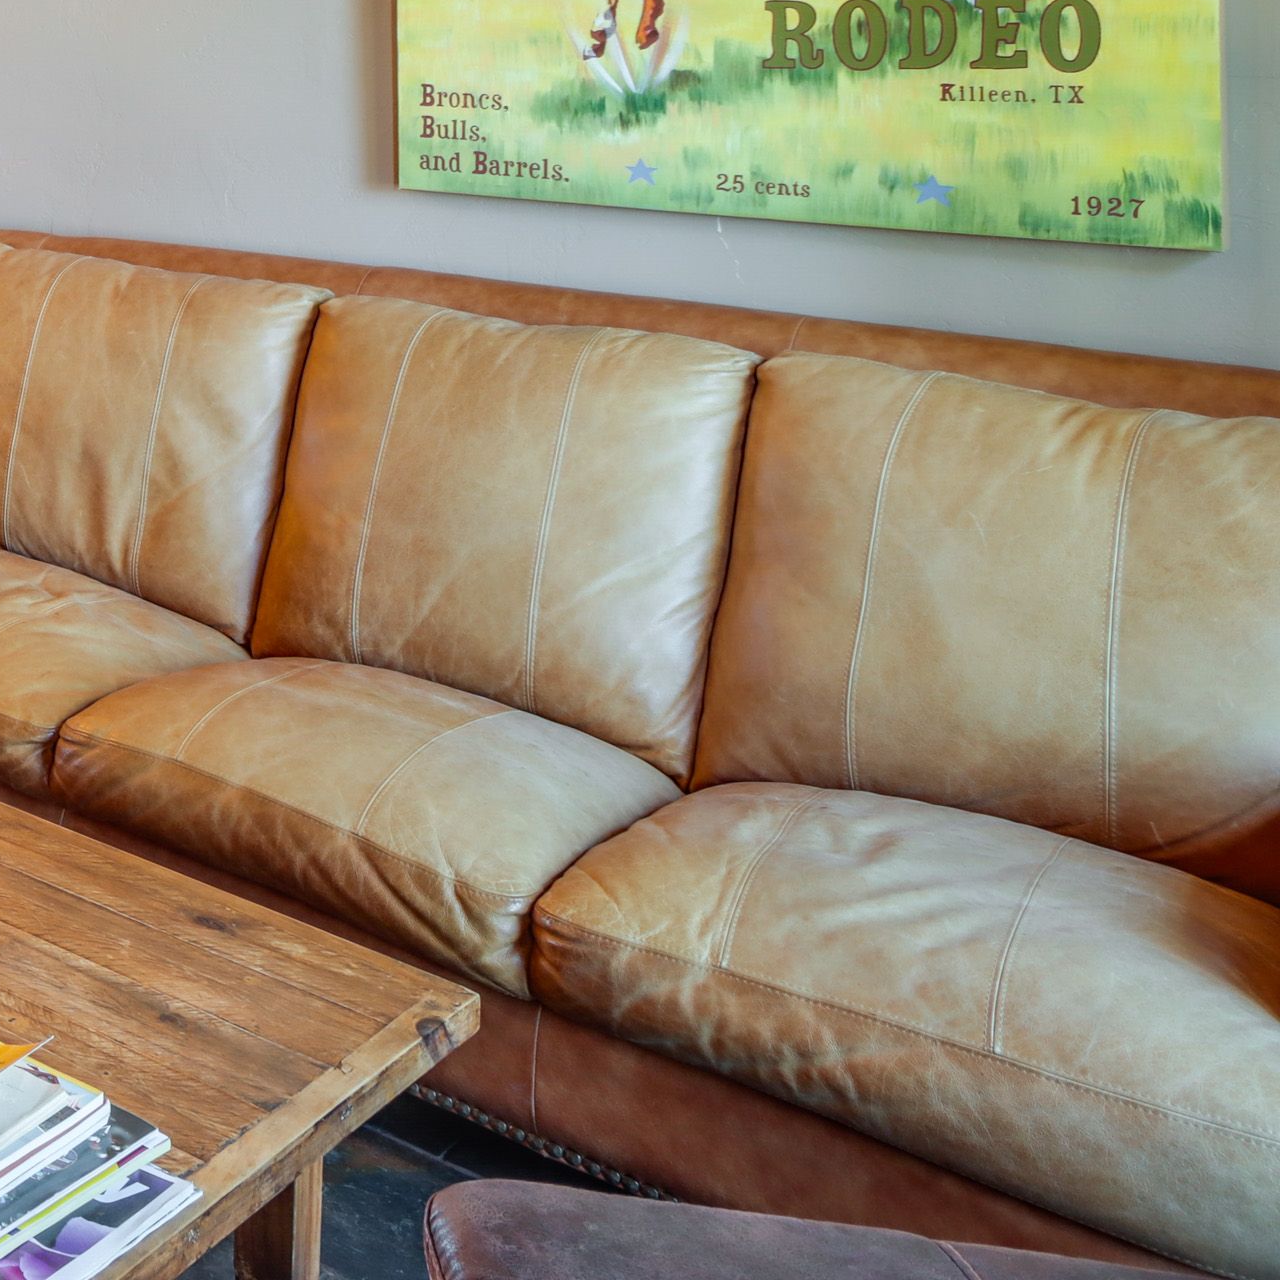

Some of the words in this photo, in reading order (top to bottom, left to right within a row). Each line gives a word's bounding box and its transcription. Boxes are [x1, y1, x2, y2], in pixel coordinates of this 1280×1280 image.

[419, 83, 510, 113] Broncs,
[1049, 85, 1086, 104] TX
[419, 115, 488, 144] Bulls,
[419, 151, 462, 173] and
[472, 151, 571, 183] Barrels.
[716, 174, 746, 194] 25
[754, 177, 811, 199] cents
[1072, 195, 1147, 220] 1927
